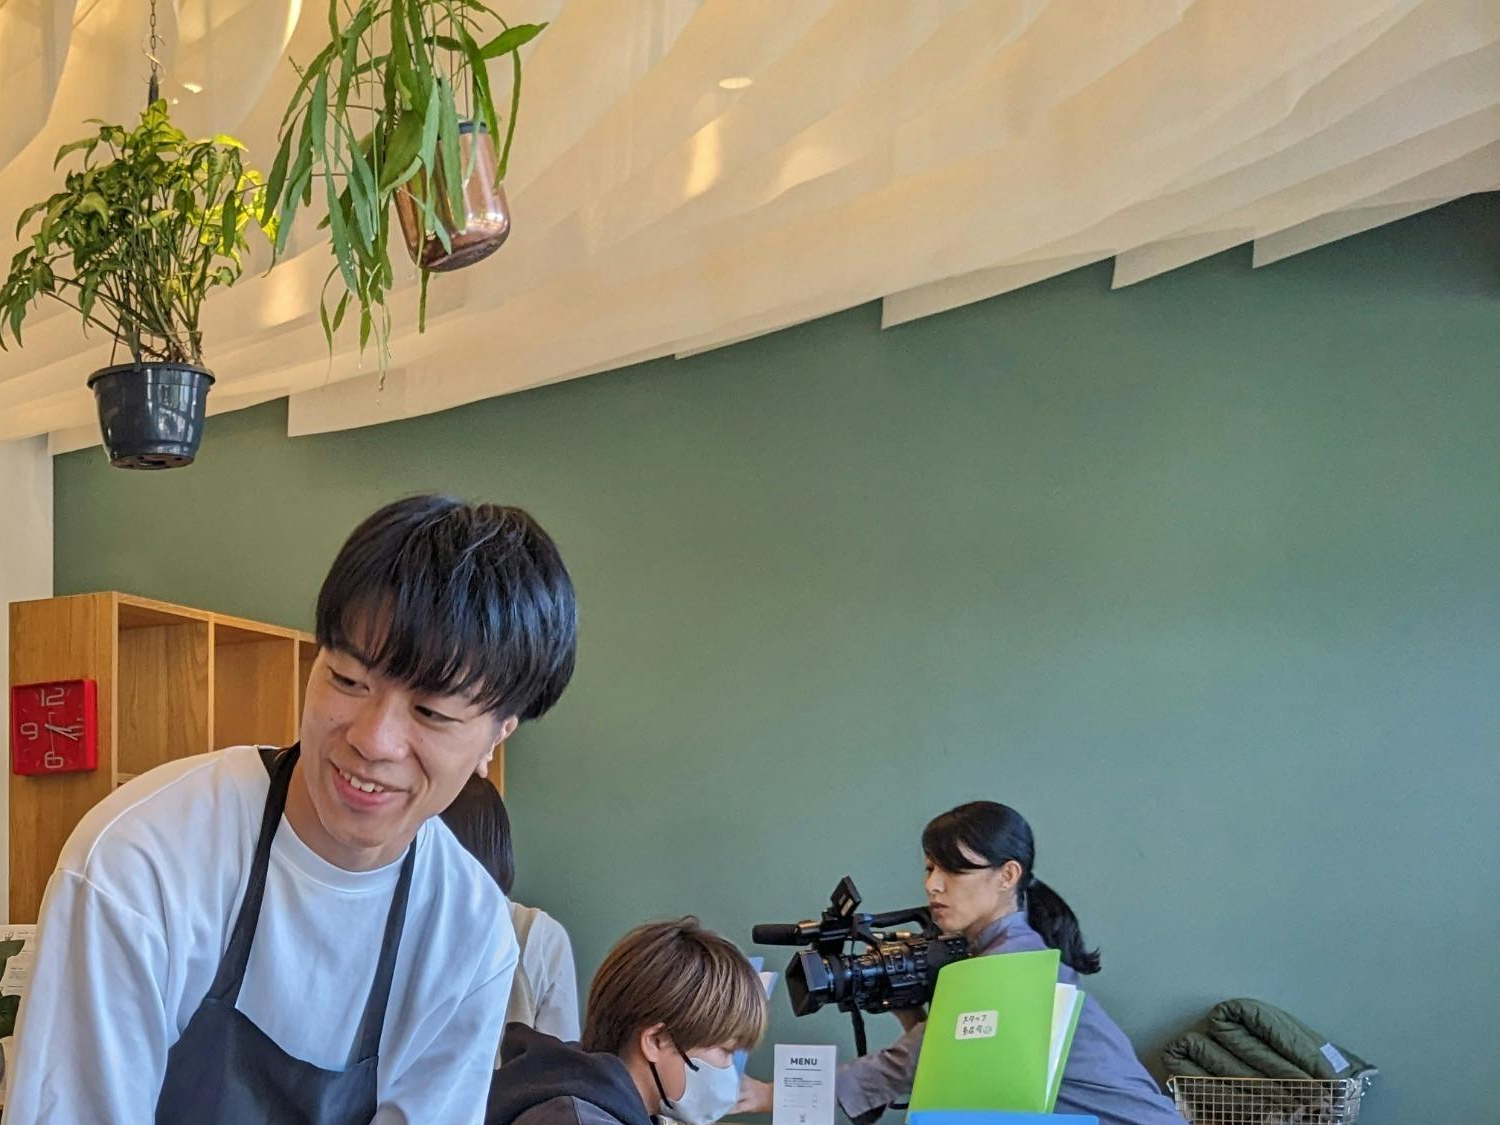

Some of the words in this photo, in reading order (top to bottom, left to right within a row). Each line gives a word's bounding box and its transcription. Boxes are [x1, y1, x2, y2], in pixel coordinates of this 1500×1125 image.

[41, 687, 65, 707] 12
[20, 722, 39, 741] 9
[44, 751, 64, 769] 6
[790, 1057, 818, 1066] MENU
